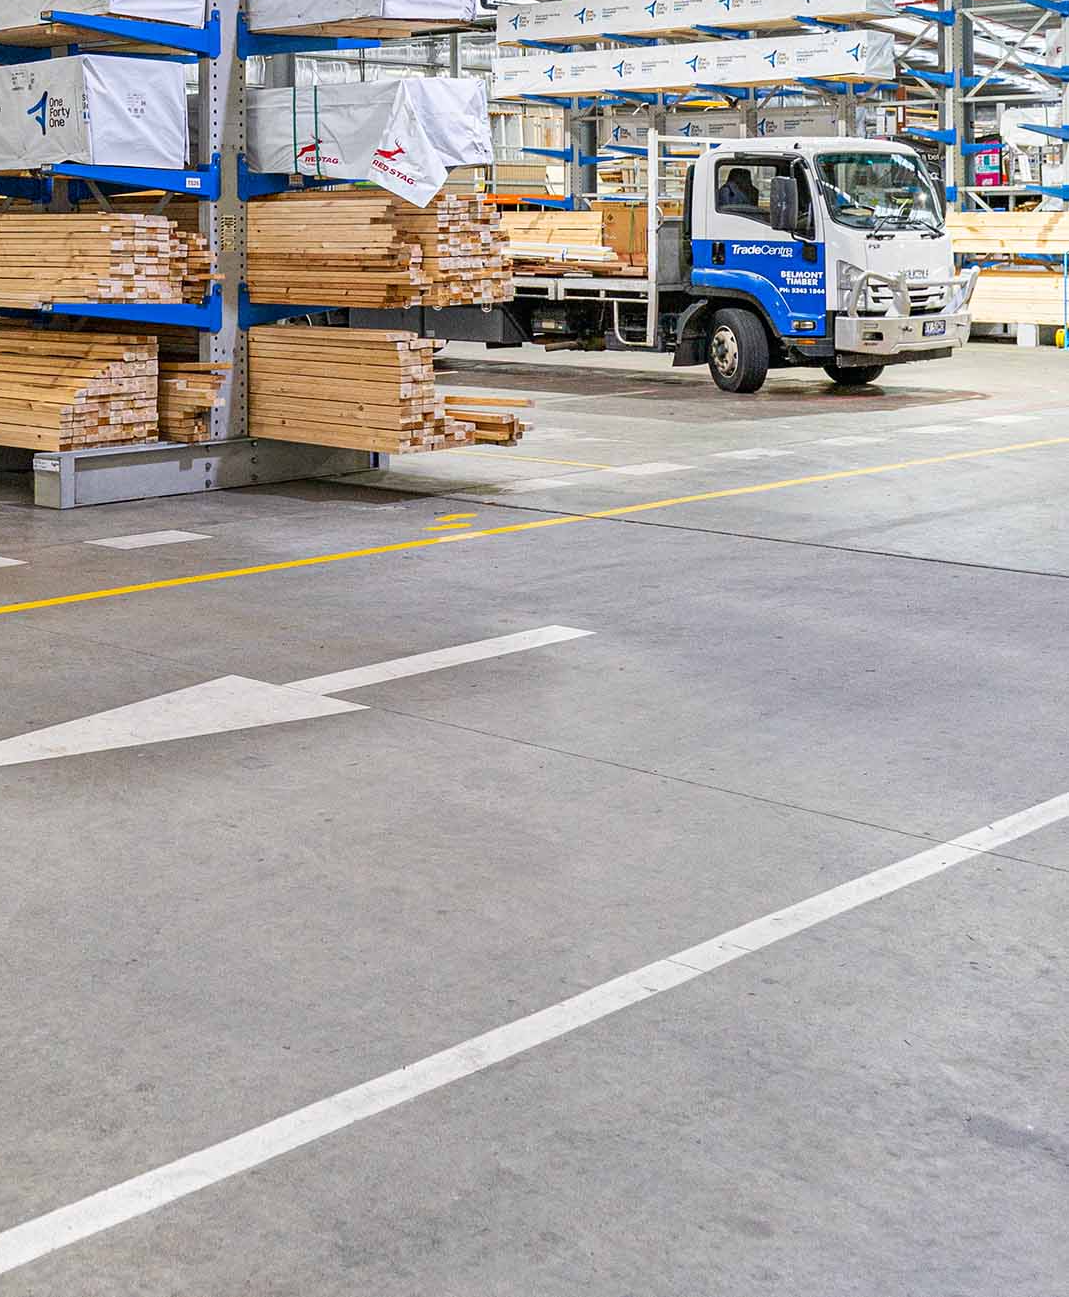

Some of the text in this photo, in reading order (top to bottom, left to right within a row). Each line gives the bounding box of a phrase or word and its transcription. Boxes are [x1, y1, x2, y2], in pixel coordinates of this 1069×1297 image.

[49, 97, 64, 108] One
[49, 106, 71, 118] Forty
[49, 117, 66, 128] One
[371, 158, 416, 186] RED STAG
[731, 244, 793, 256] TradeCentre
[780, 270, 824, 279] BELMONT
[785, 278, 819, 286] TIMBER
